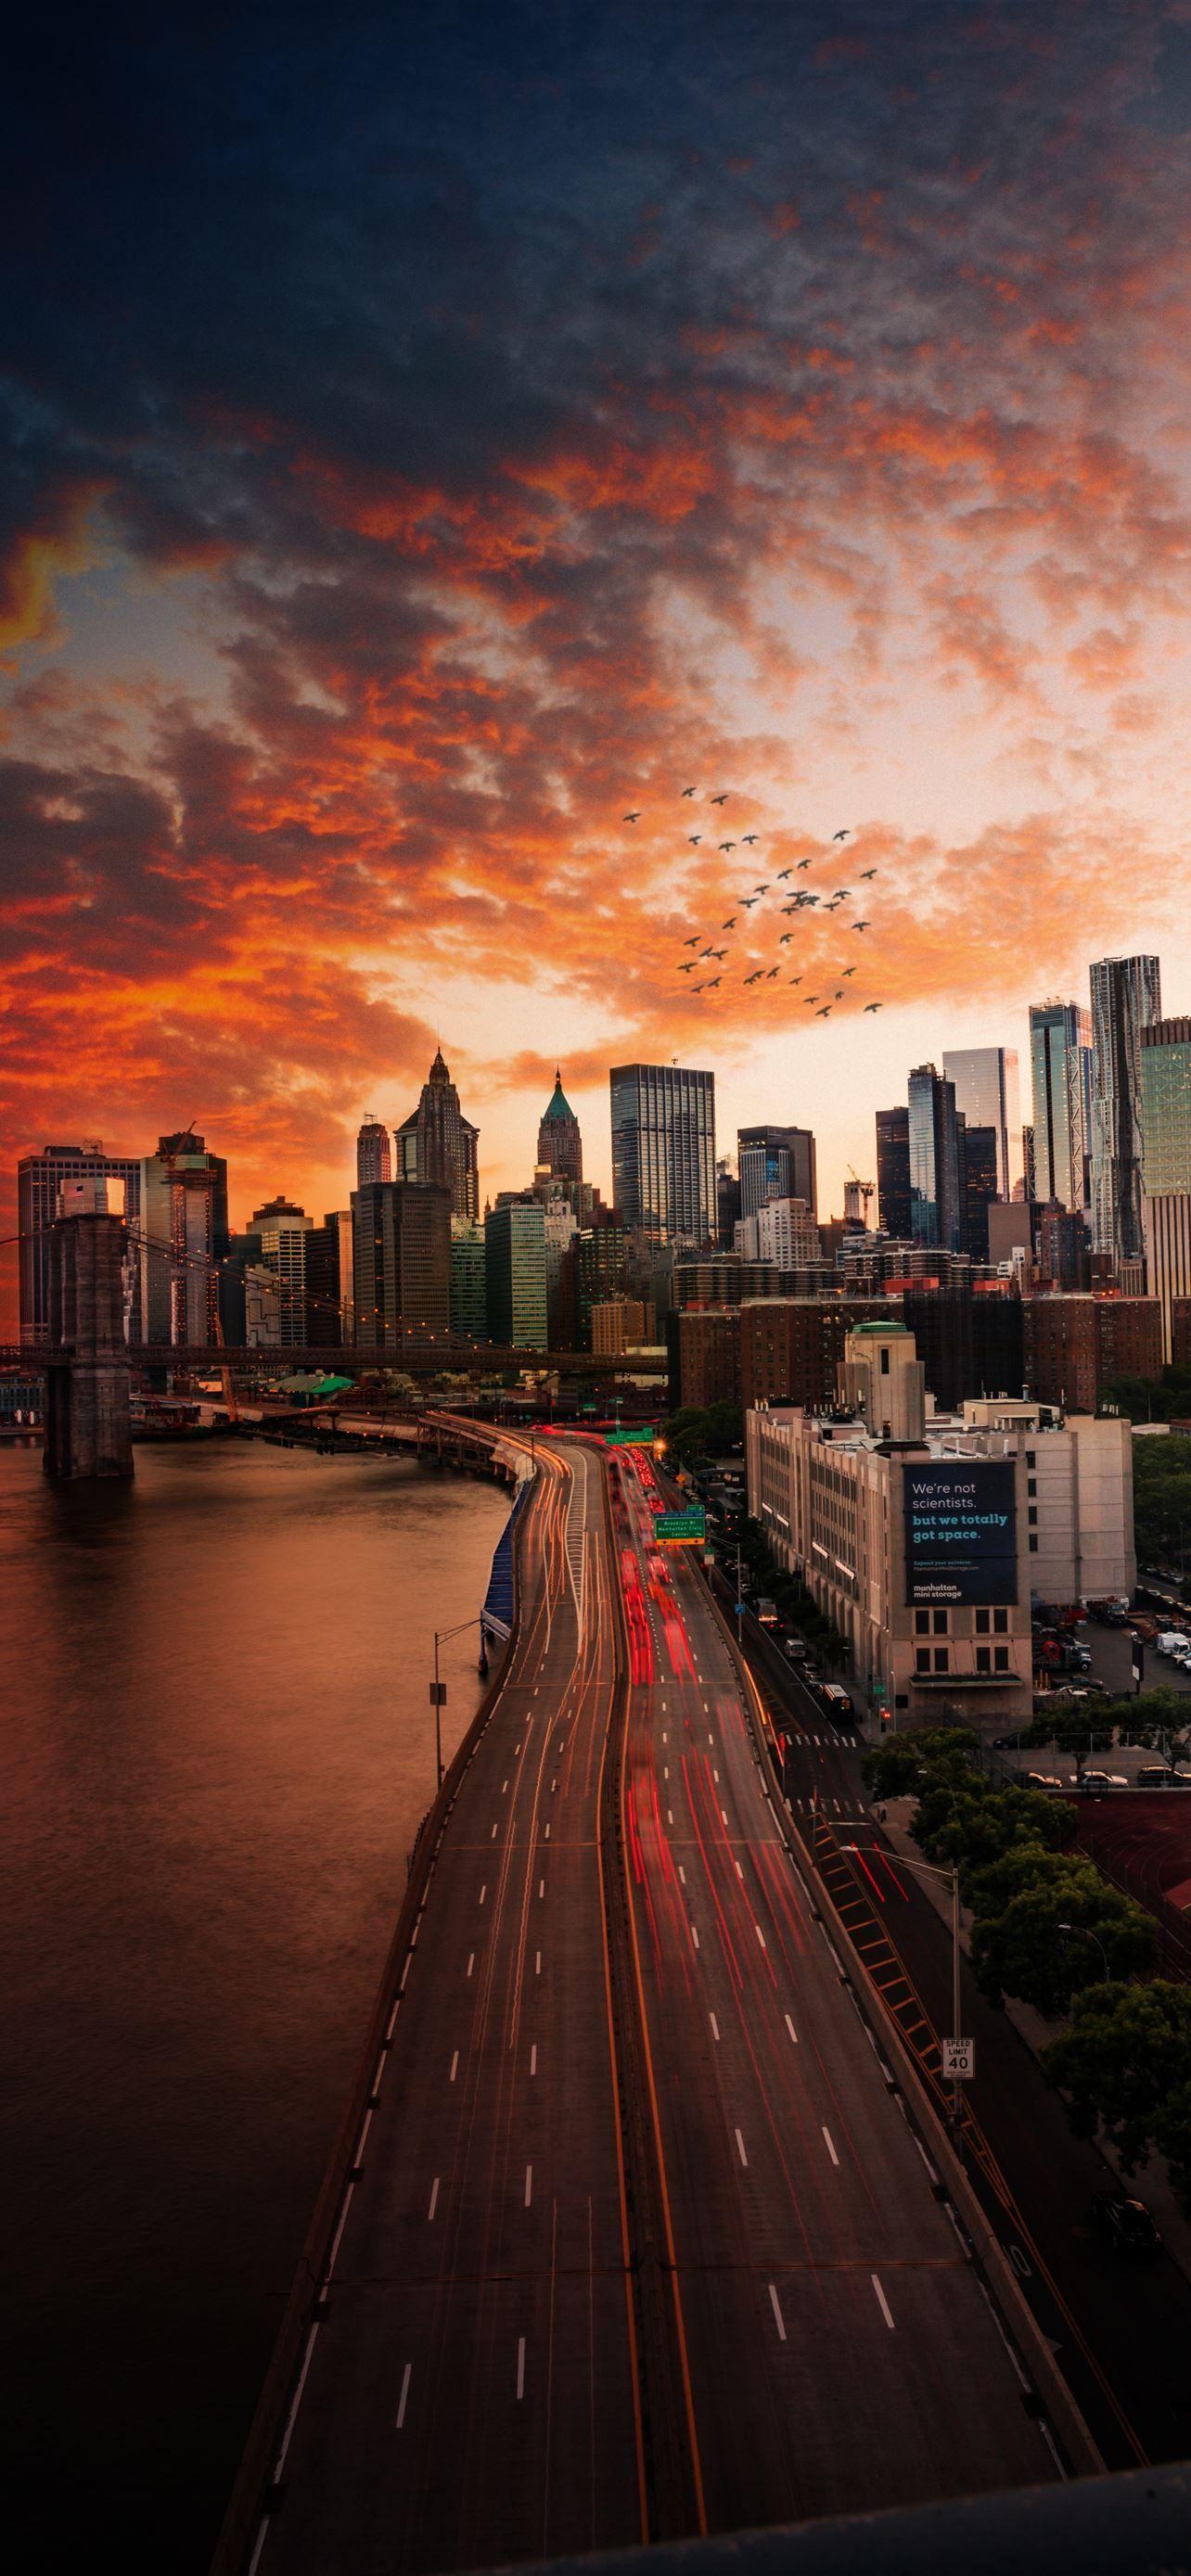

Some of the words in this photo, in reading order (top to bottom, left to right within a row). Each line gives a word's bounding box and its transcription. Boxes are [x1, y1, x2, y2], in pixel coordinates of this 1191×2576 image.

[912, 1483, 951, 1494] We're
[954, 1484, 976, 1493] not
[913, 1515, 937, 1525] but
[939, 1516, 958, 1524] we
[961, 1513, 1008, 1526] totally
[913, 1530, 935, 1543] got
[938, 1531, 981, 1542] space.
[914, 1583, 957, 1591] manhattan
[931, 1591, 962, 1600] storage
[949, 2057, 967, 2069] 40
